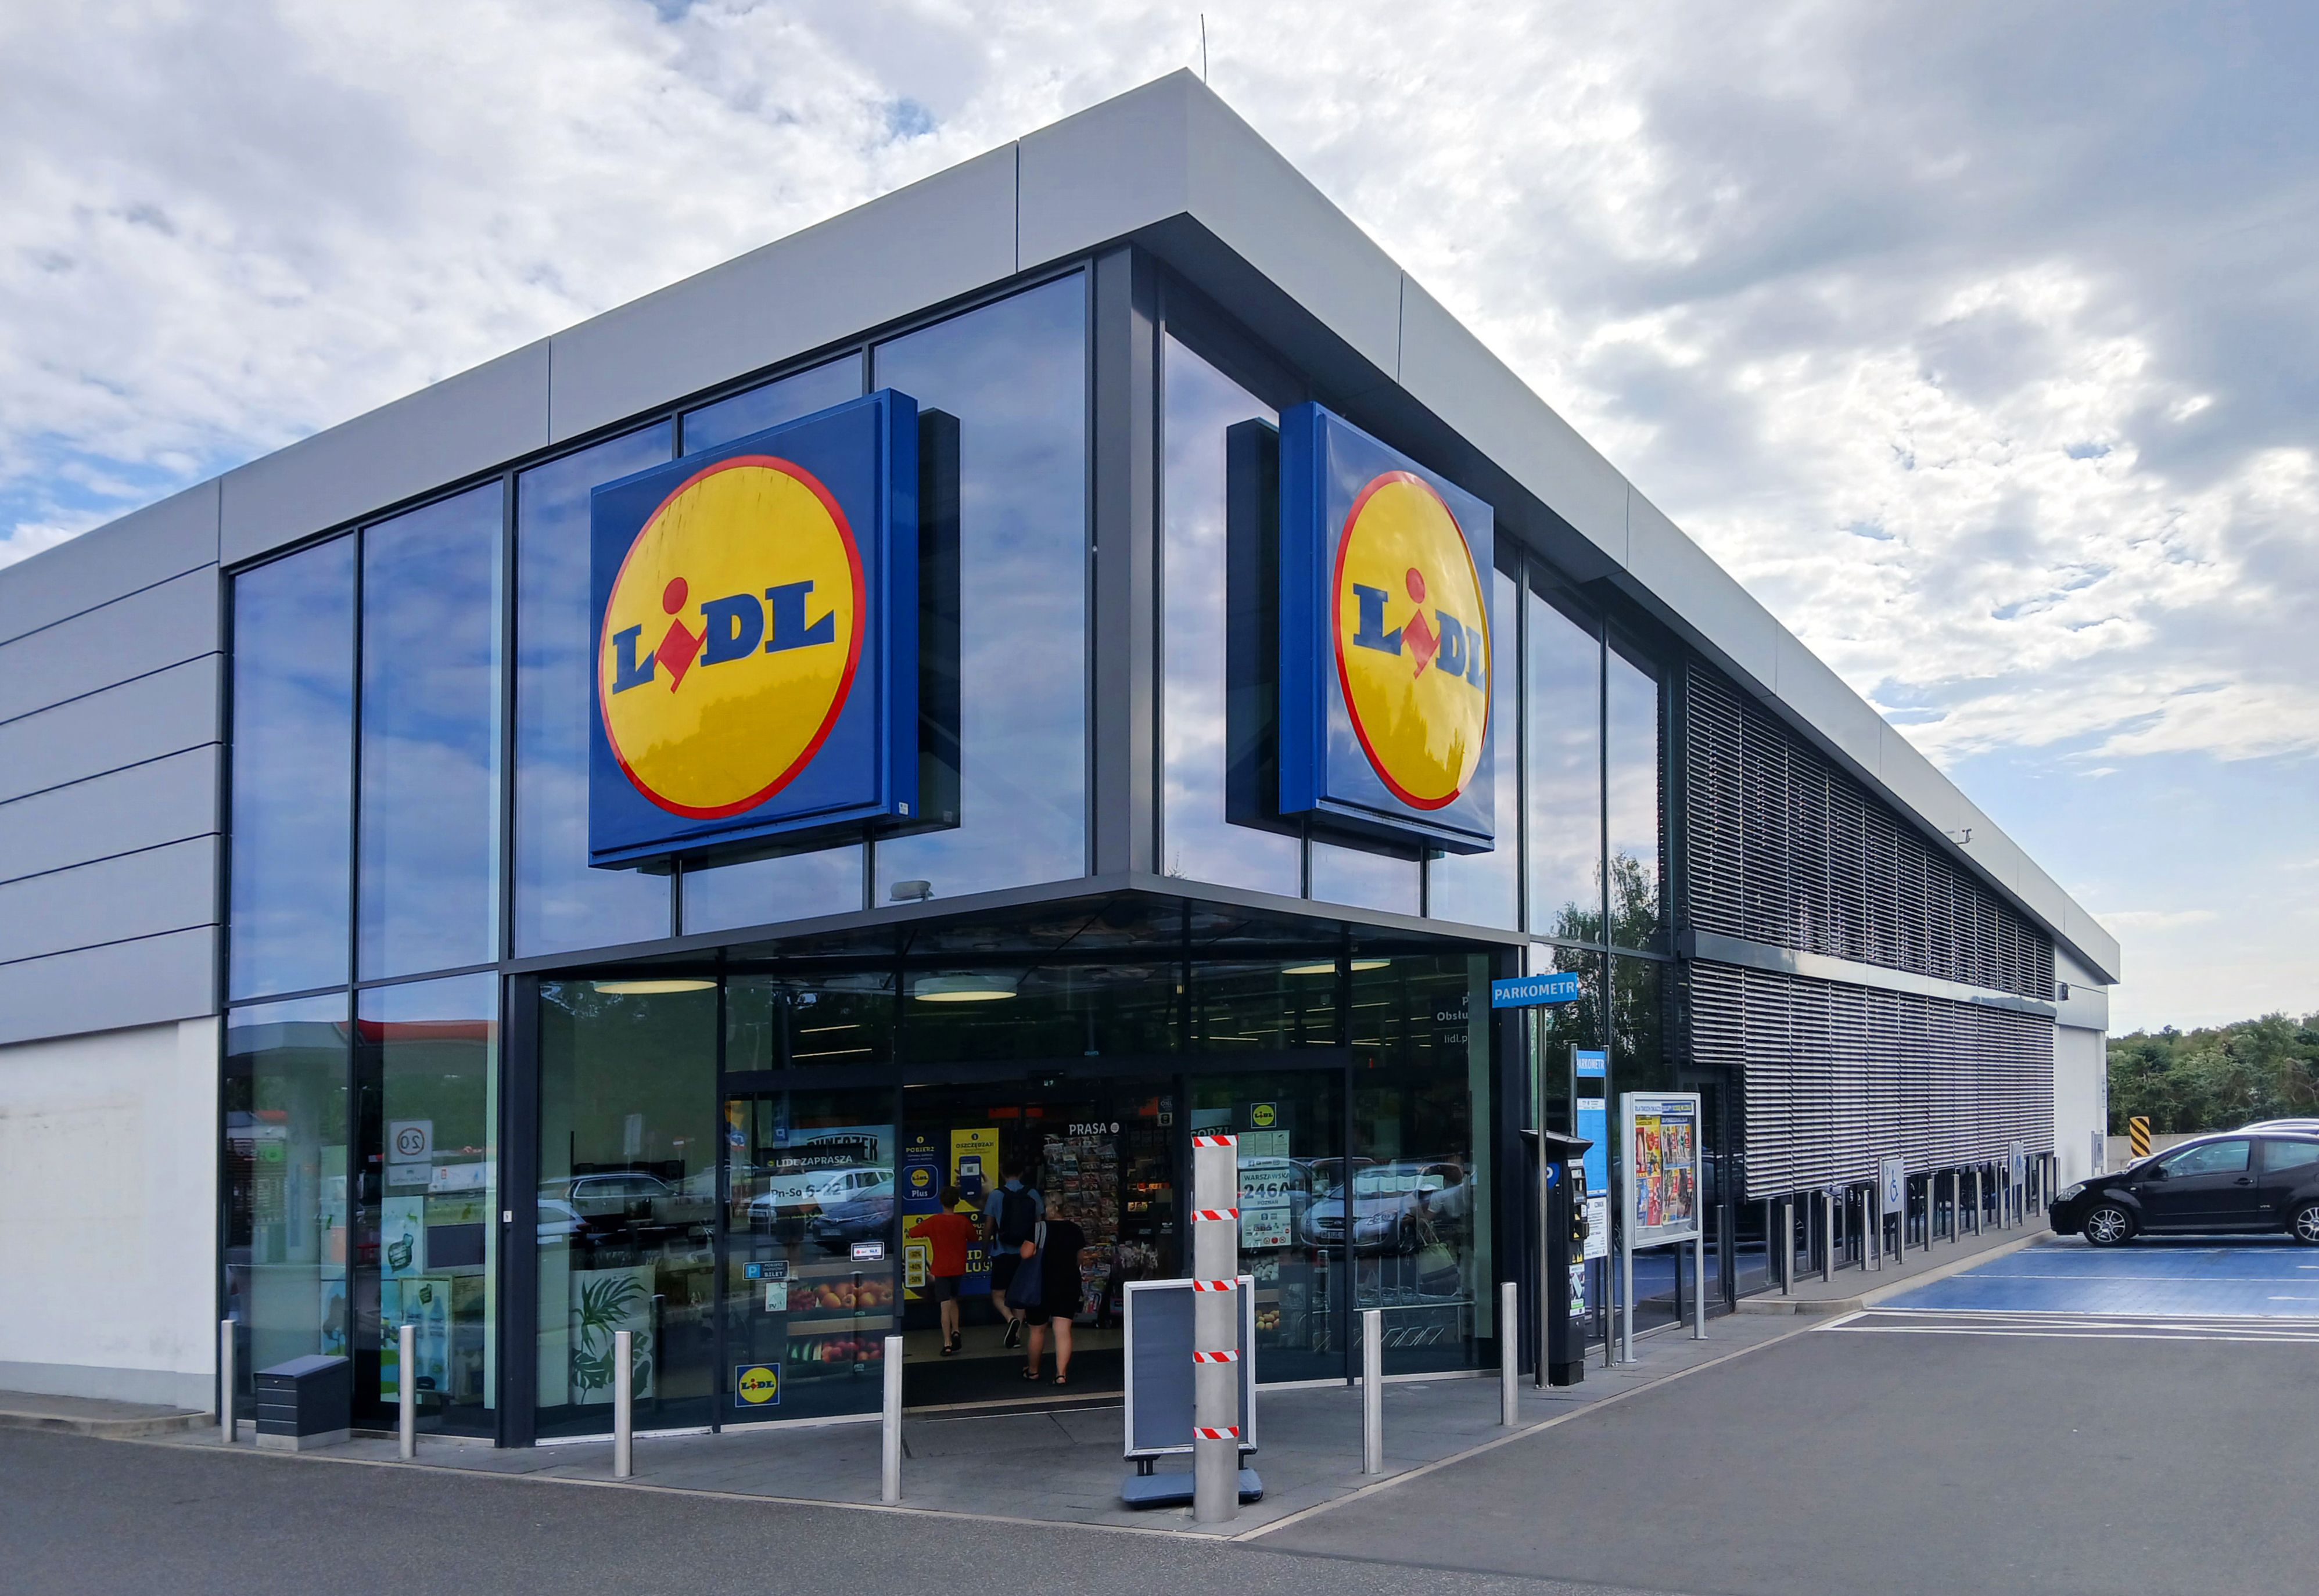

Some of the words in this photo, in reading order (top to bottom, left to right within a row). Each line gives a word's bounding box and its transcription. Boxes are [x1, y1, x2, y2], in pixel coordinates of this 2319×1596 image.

[612, 577, 835, 695] LIDL
[1352, 567, 1486, 694] LIDL
[1495, 982, 1575, 1000] PARKOMETR
[1254, 1111, 1273, 1119] LIDL
[1069, 1123, 1107, 1135] PRASA
[801, 1155, 853, 1166] ZAPRASZA
[771, 1188, 802, 1198] Pn-So
[911, 1189, 928, 1198] Plus
[1243, 1182, 1290, 1199] 246A
[748, 1266, 758, 1277] P
[741, 1378, 774, 1392] LIDL
